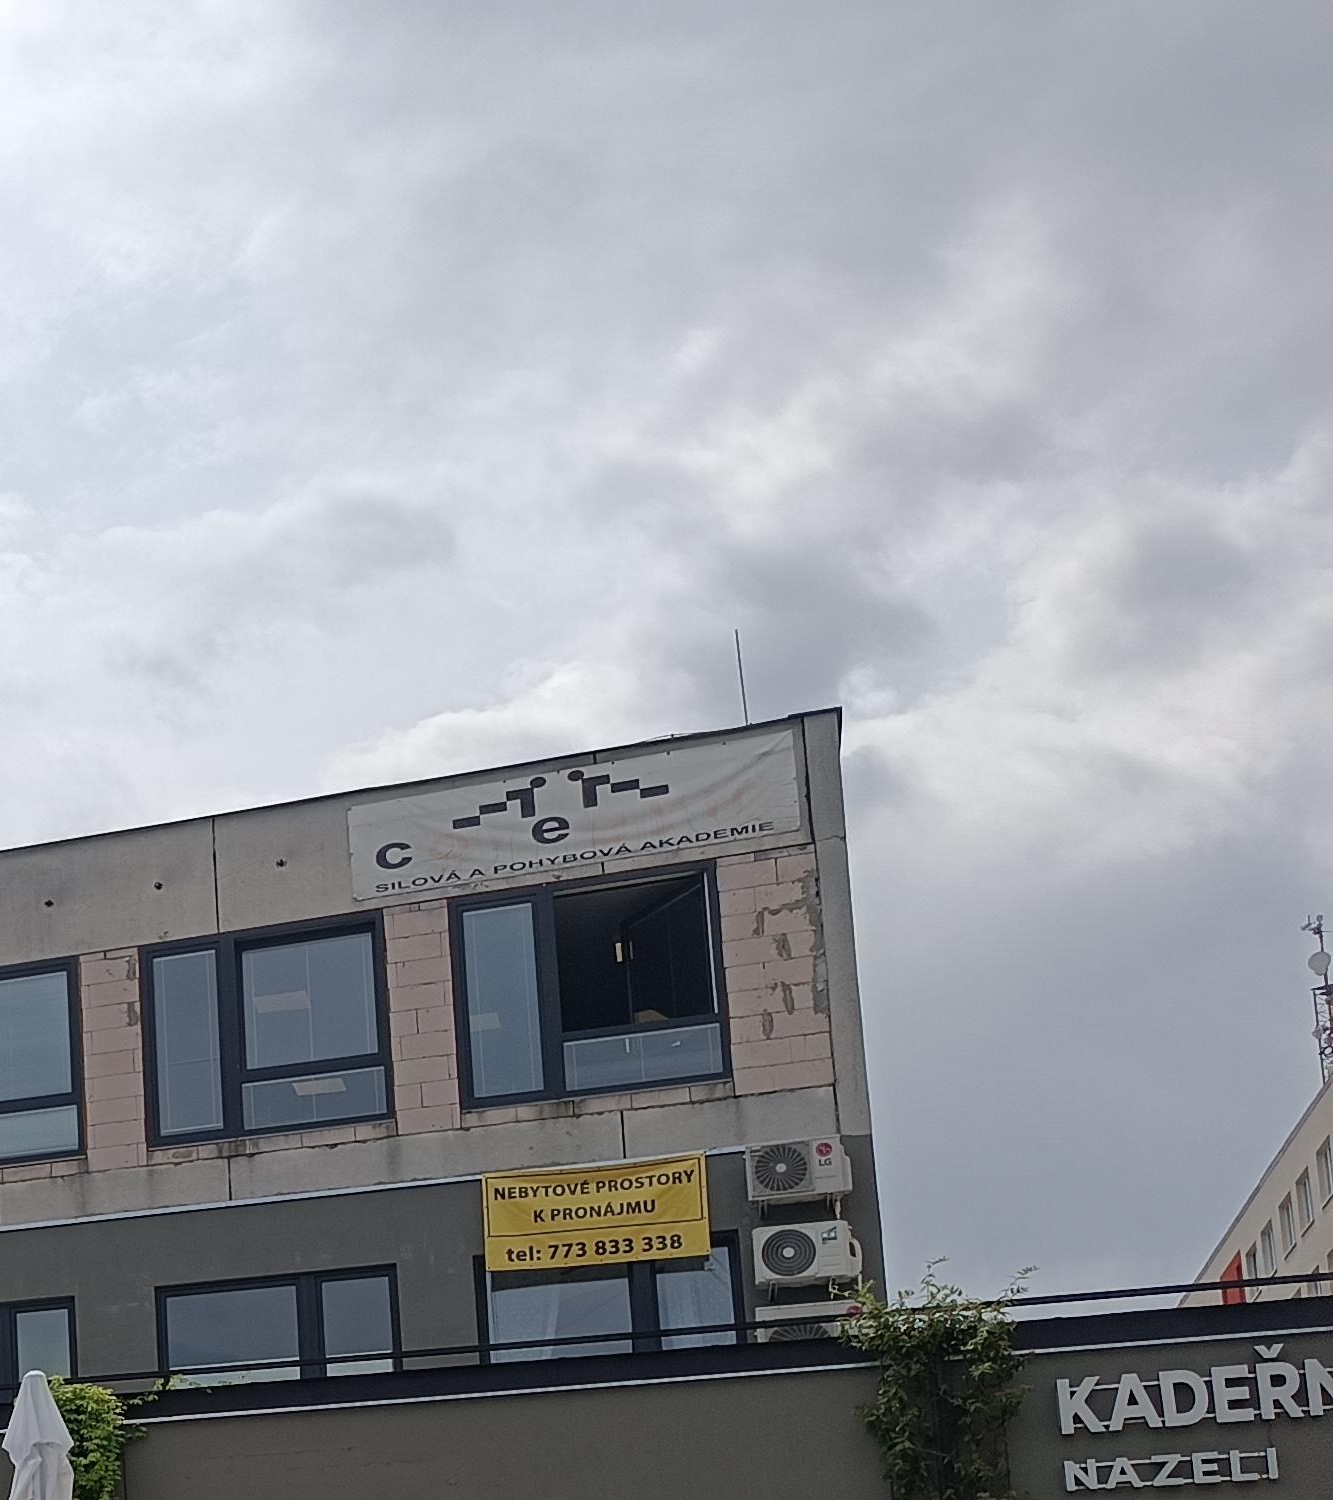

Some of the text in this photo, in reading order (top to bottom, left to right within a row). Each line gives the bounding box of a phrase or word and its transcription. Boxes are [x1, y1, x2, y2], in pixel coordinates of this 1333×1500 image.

[374, 821, 775, 893] SILOVÁ A POHYBOVÁ AKADEMIE
[818, 1158, 832, 1167] LG
[494, 1169, 695, 1201] NEBYTOVÉ PROSTORY
[533, 1199, 657, 1224] K PRONÁJMU
[506, 1234, 683, 1264] tel: 773 833 338
[1064, 1447, 1279, 1492] NAZELI
